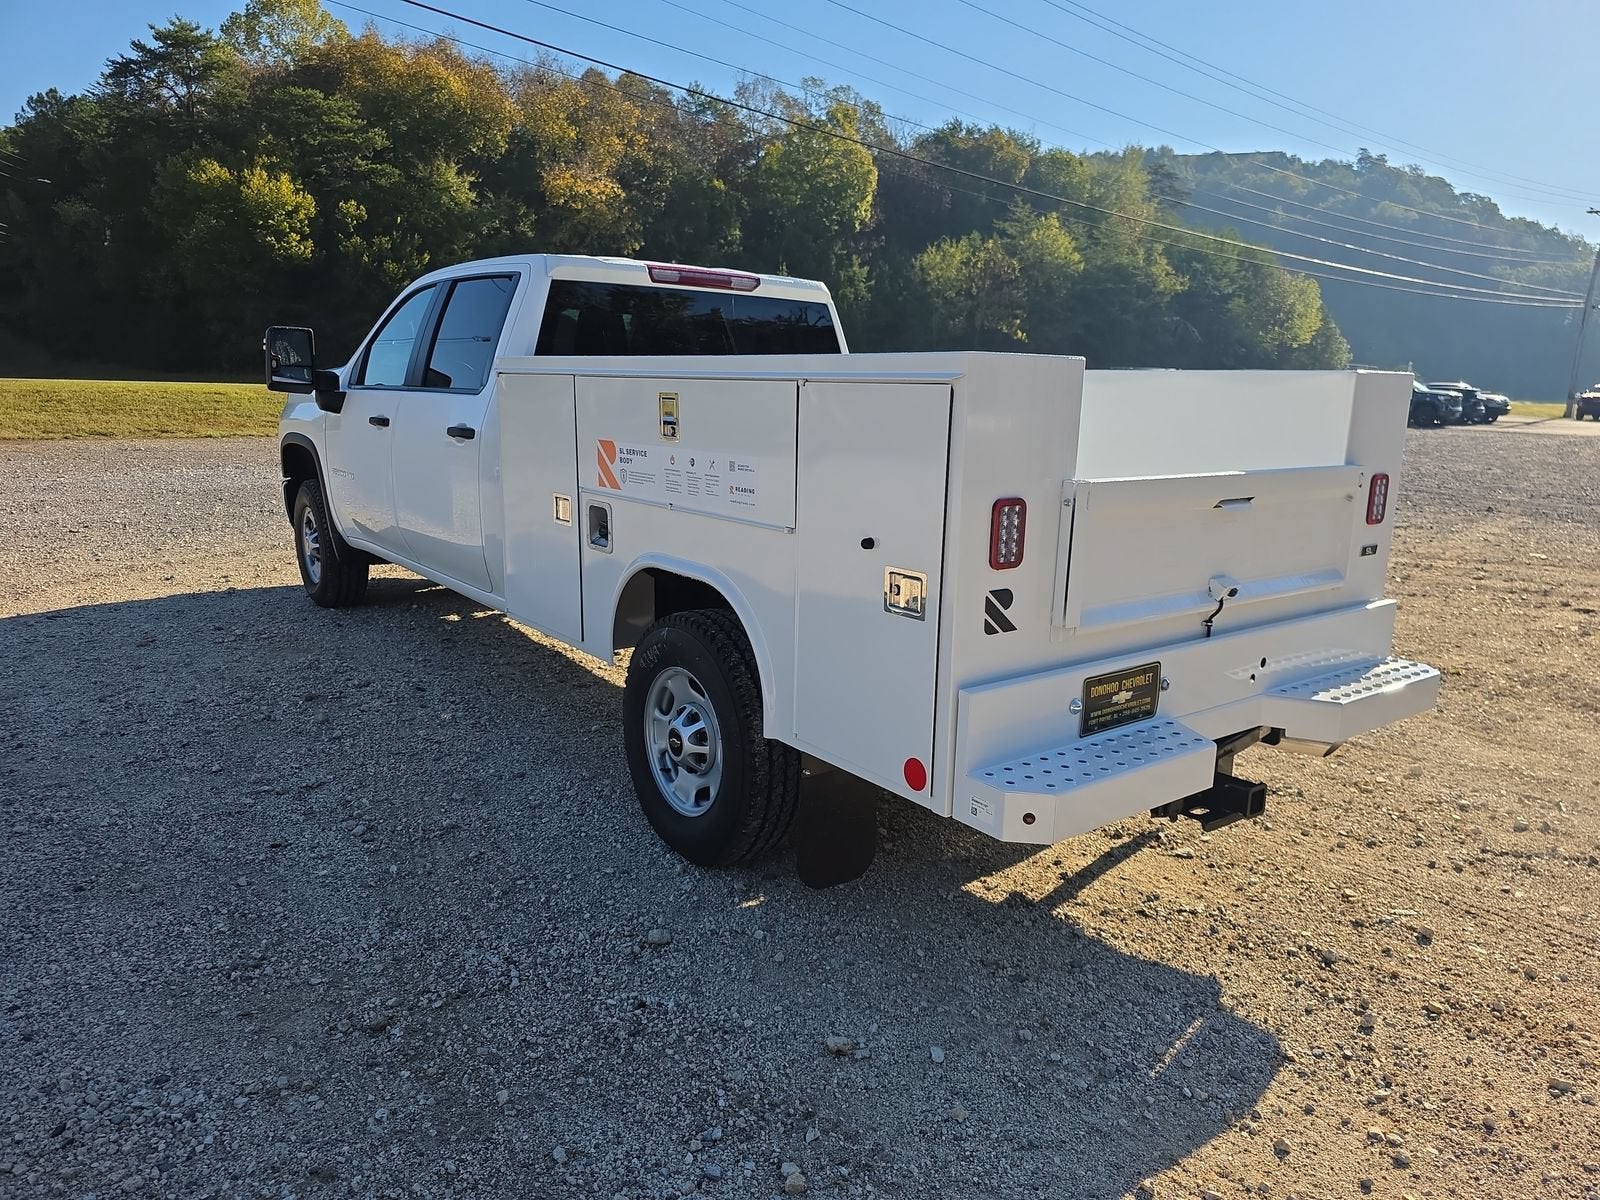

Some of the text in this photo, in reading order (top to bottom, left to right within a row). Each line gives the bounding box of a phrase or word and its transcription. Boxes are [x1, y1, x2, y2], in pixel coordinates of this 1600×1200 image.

[626, 448, 648, 458] SERVICE
[619, 456, 633, 465] BODY
[735, 486, 756, 495] READING
[1091, 673, 1153, 698] DONOHOO CHEVROLET
